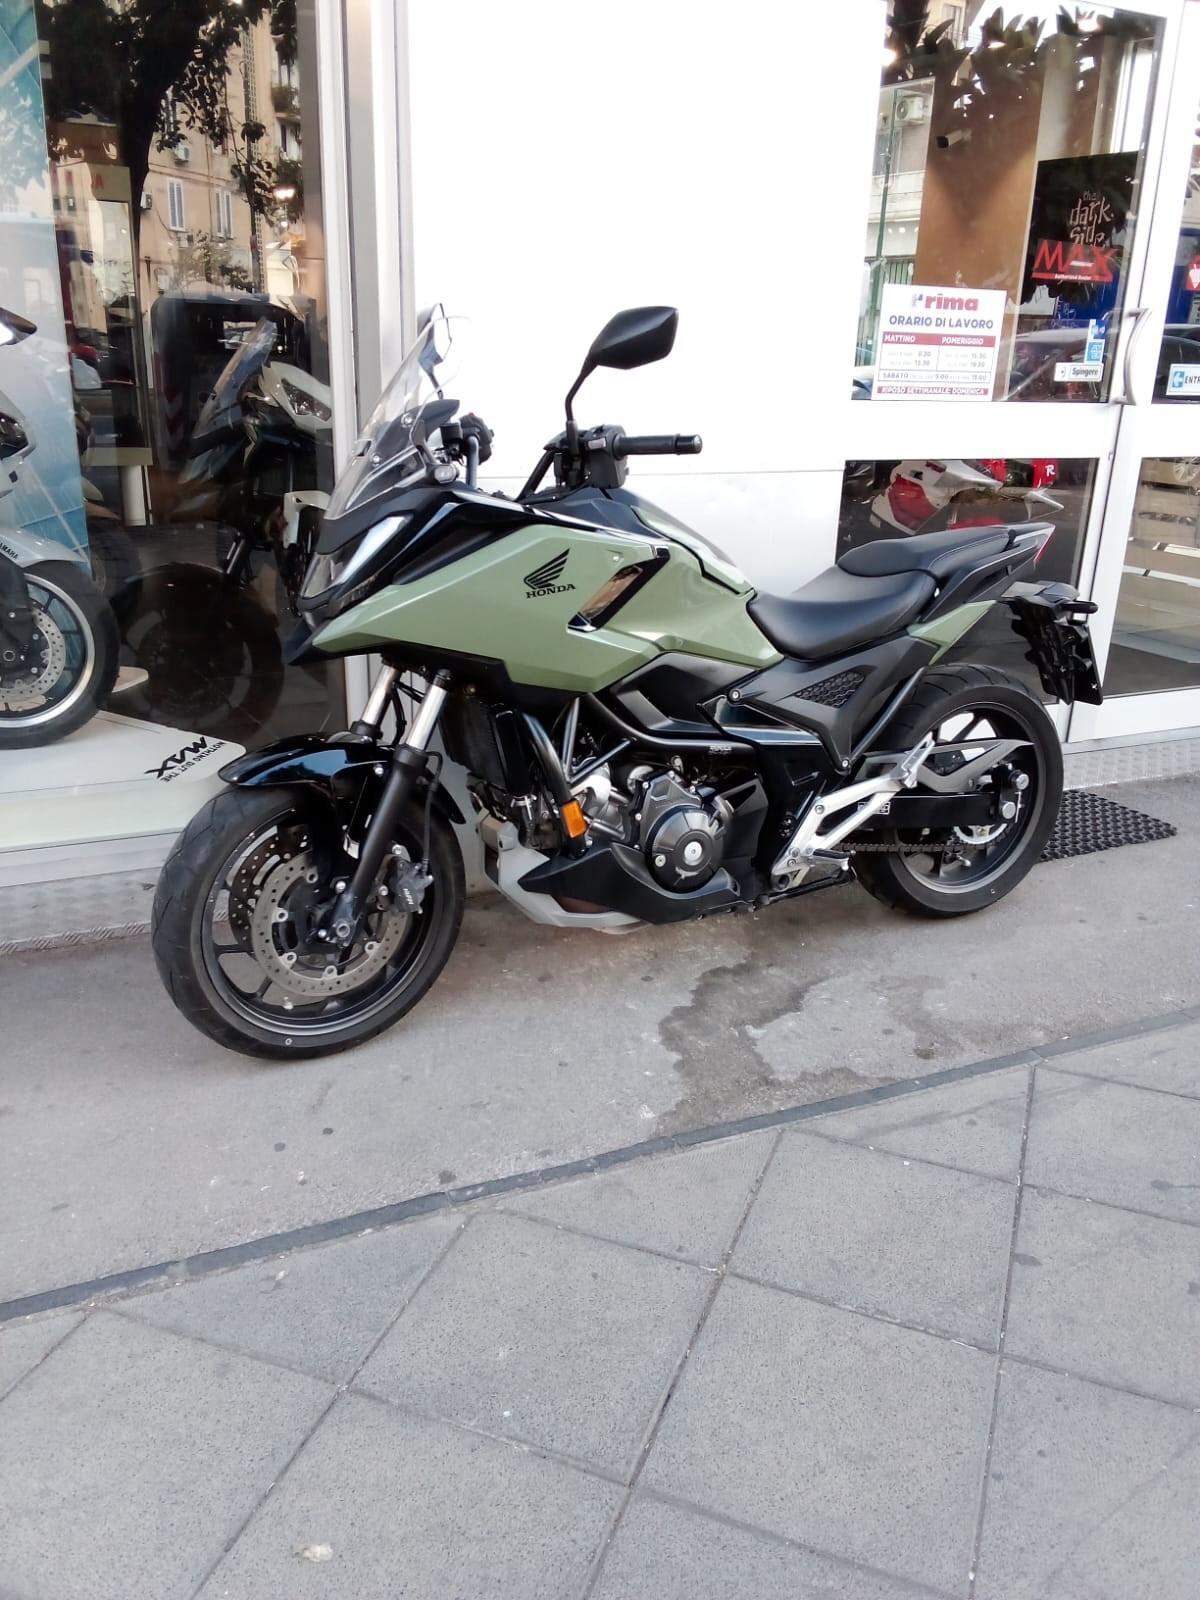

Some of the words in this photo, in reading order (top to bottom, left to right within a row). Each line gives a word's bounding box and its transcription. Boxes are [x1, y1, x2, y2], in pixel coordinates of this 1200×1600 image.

[1032, 240, 1118, 280] MAX
[889, 315, 932, 327] ORARIO
[935, 317, 946, 327] DI
[949, 319, 994, 329] LAVORO
[884, 334, 916, 343] MATTINO
[941, 336, 984, 345] POMERIGGIO
[1072, 367, 1099, 377] Spingere
[0, 542, 19, 559] AMAHA
[525, 584, 577, 599] HONDA
